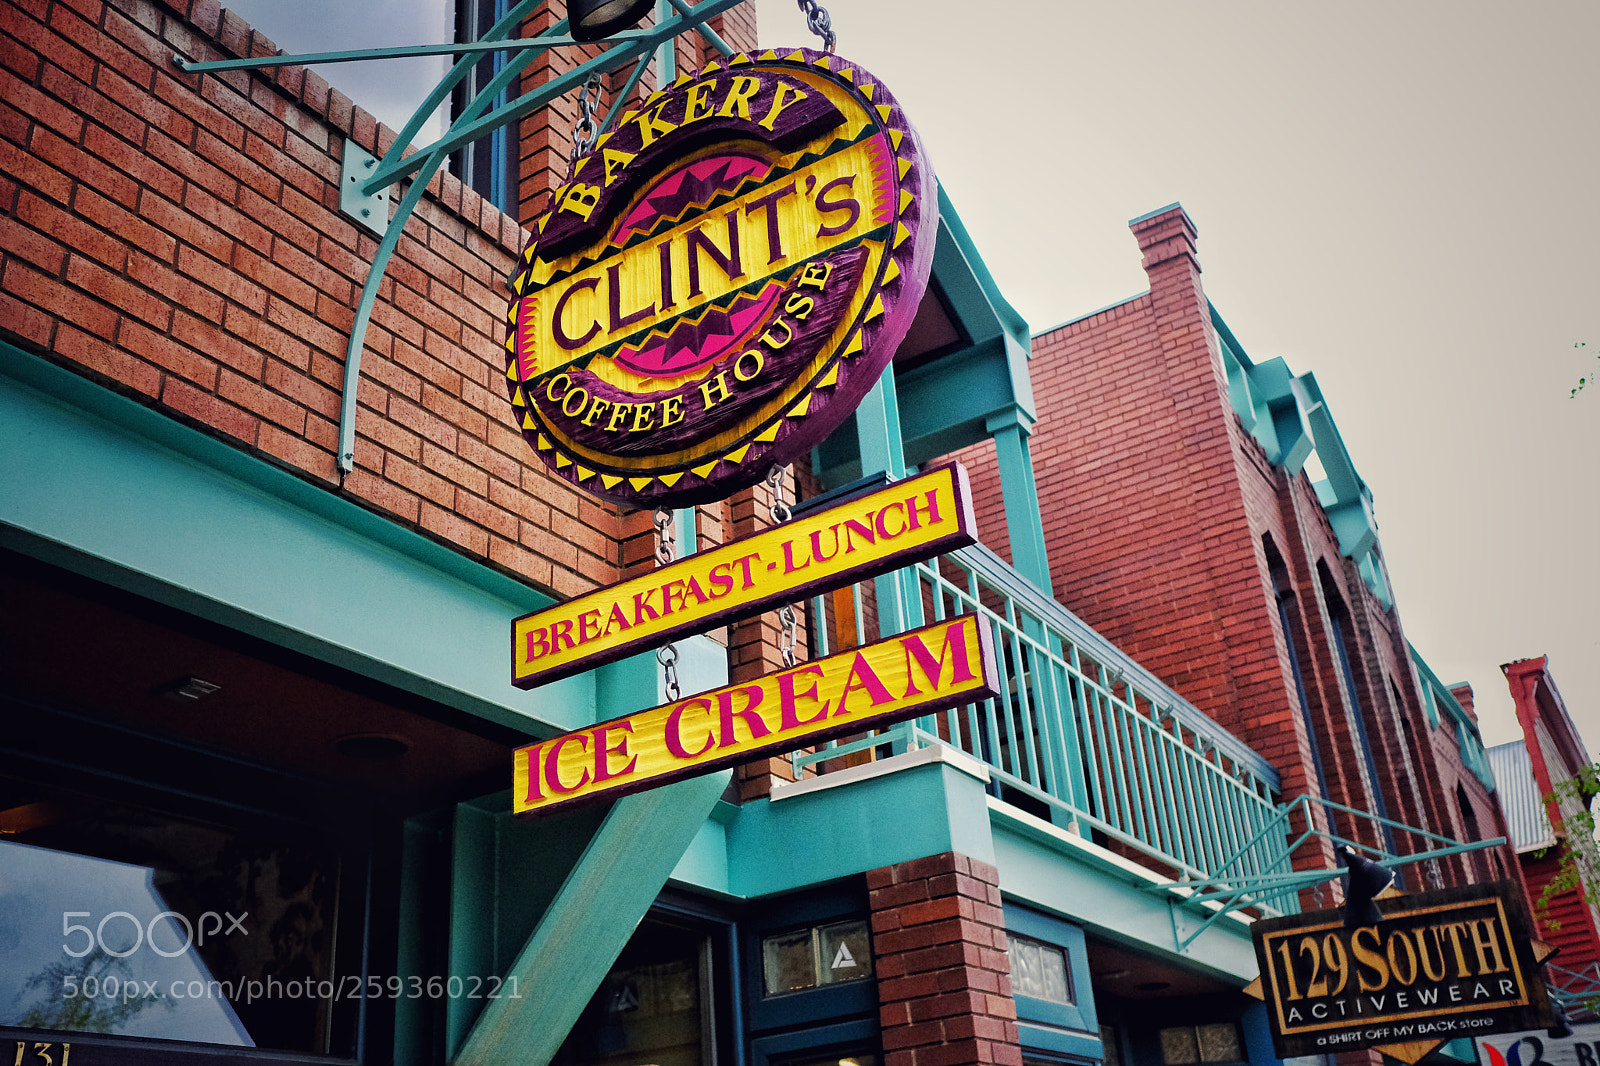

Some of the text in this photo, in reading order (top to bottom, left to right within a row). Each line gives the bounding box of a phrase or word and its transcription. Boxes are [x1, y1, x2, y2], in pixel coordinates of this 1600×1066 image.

[559, 75, 808, 223] BAKERY
[551, 173, 861, 350] CLINT'S
[546, 261, 833, 432] COFFEE HOUSE
[524, 620, 977, 803] ICE CREAM
[1288, 979, 1515, 1022] ACTIVEWEAR
[1317, 1016, 1494, 1046] a SHIRT OFF MY BACK store
